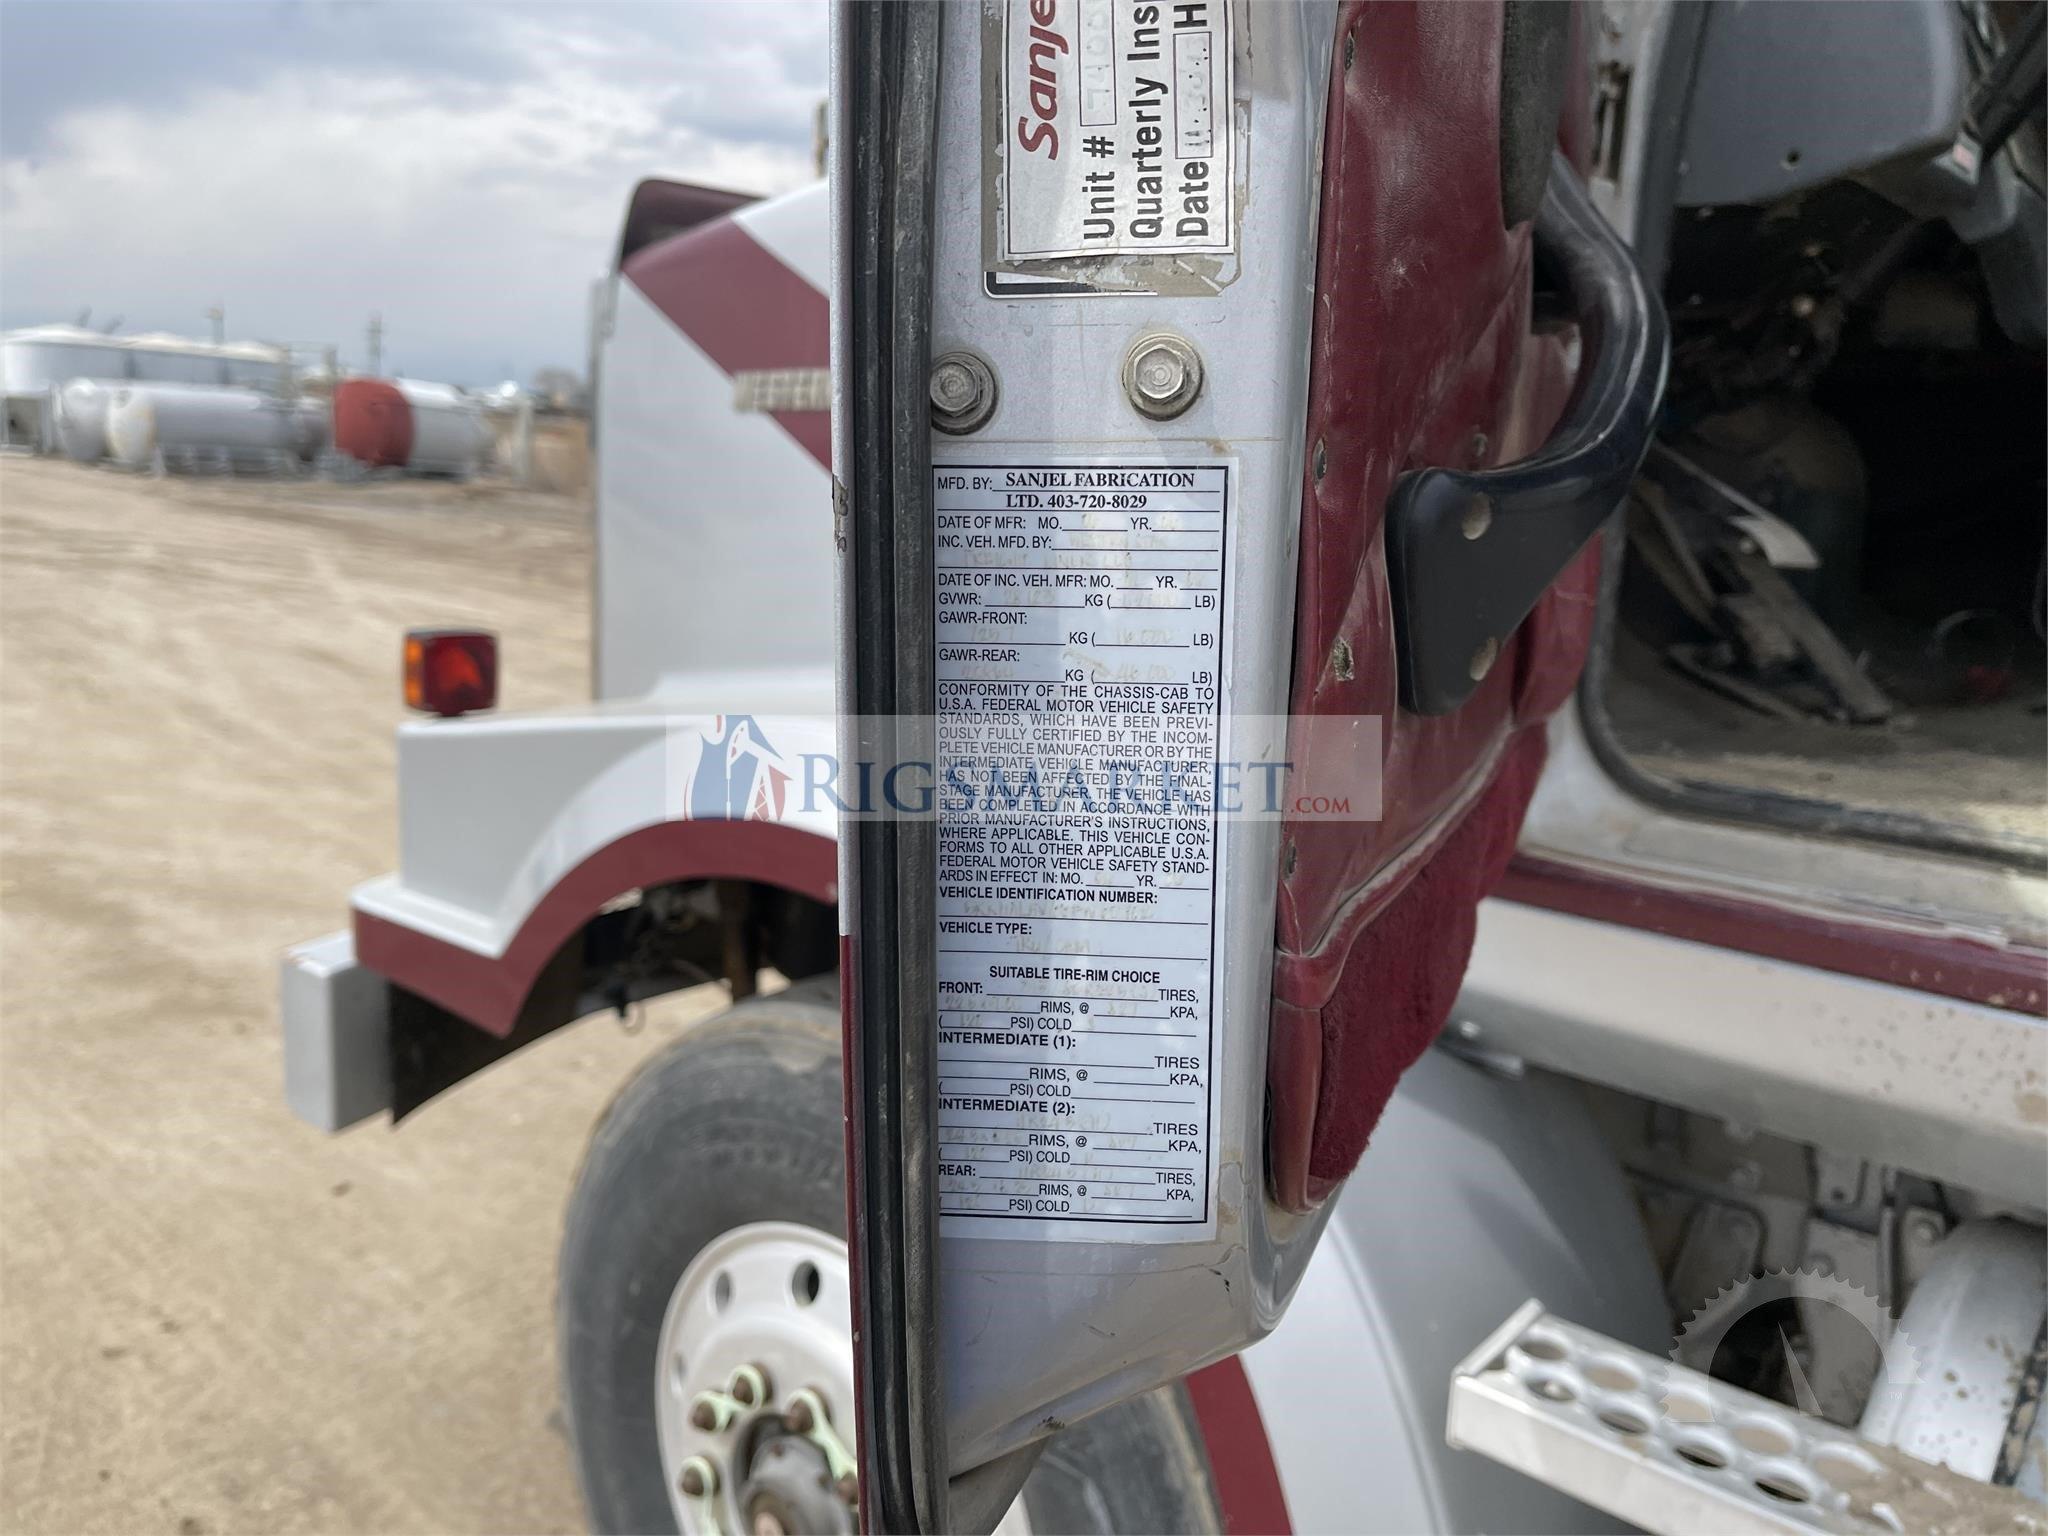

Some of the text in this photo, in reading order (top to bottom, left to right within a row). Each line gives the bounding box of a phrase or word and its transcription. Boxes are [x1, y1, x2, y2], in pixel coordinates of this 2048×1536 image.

[1127, 0, 1168, 239] Quarterly Ins
[1082, 136, 1115, 239] Unit #
[1176, 161, 1209, 237] Date
[938, 473, 1194, 490] MFD. BY: SANJEL FABRICATION
[1006, 495, 1147, 509] LTD. 403-720-8029
[938, 517, 971, 528] DATE
[974, 517, 991, 528] OF
[995, 517, 1026, 529] MFR:
[1038, 517, 1062, 529] MO.
[1131, 518, 1151, 530] YR.
[938, 536, 1051, 549] INC. VEH. MFD. BY:
[938, 574, 971, 586] DATE
[974, 574, 991, 586] OF
[995, 574, 1020, 586] INC.
[1023, 575, 1052, 587] VEH.
[1056, 575, 1086, 587] MFR:
[1090, 576, 1113, 588] MO.
[1156, 576, 1177, 589] YR.
[939, 593, 1215, 608] GVWR: KG LB)
[939, 612, 1027, 624] GAWR-FRONT:
[1070, 633, 1213, 647] KG LB)
[939, 650, 1019, 661] GAWR-REAR:
[1065, 670, 1212, 685] KG LB)
[939, 684, 1214, 699] CONFORMITY OF THE CHASSIS-CAB TO
[939, 698, 1213, 714] U.S.A. FEDERAL MOTOR VEHICLE SAFETY
[939, 713, 1213, 728] STANDARDS, WHICH HAVE BEEN PREVI-
[939, 727, 1212, 743] OUSLY FULLY CERTIFIED BY THE INCOM-
[940, 742, 1212, 758] PLETE VEHICLE MANUFACTURER OR BY THE
[940, 756, 1211, 774] INTERMEDIATE VEHICLE MANUFACTURER,
[940, 771, 1211, 787] HAS NOT BEEN AFFECTED BY THE FINAL-
[940, 785, 1211, 801] STAGE MANUFACTURER. THE VEHICLE HAS
[940, 799, 1210, 816] BEEN COMPLETED IN ACCORDANCE WITH
[940, 814, 1209, 832] PRIOR MANUFACTURER'S INSTRUCTIONS,
[940, 828, 1209, 845] WHERE APPLICABLE. THIS VEHICLE CON-
[940, 842, 1208, 859] FORMS TO ALL OTHER APPLICABLE U.S.A.
[940, 856, 1209, 873] FEDERAL MOTOR VEHICLE SAFETY STAND-
[940, 870, 974, 881] ARDS
[976, 871, 988, 882] IN
[991, 871, 1037, 883] EFFECT
[1042, 872, 1058, 884] IN:
[1061, 873, 1083, 884] MO.
[1137, 875, 1156, 887] YR.
[940, 887, 1157, 904] VEHICLE IDENTIFICATION NUMBER:
[940, 922, 1031, 935] VEHICLE TYPE:
[990, 966, 1160, 983] SUITABLE TIRE-RIM CHOICE
[939, 982, 983, 994] FRONT:
[1158, 989, 1198, 1003] TIRES,
[1041, 1002, 1198, 1020] RIMS, @ KPA,
[1010, 1018, 1071, 1030] PSI) COLD
[939, 1032, 1076, 1048] INTERMEDIATE (1):
[1155, 1057, 1199, 1069] TIRES
[1029, 1068, 1203, 1088] RIMS, @ KPA,
[1010, 1084, 1071, 1097] PSI) COLD
[939, 1099, 1075, 1115] INTERMEDIATE (2):
[1153, 1123, 1198, 1136] TIRES
[1029, 1135, 1201, 1154] RIMS, @ KPA,
[1009, 1151, 1070, 1164] PSI) COLD
[939, 1166, 1195, 1187] REAR: TIRES,
[1039, 1184, 1072, 1197] RIMS,
[1077, 1185, 1087, 1197] @
[1166, 1189, 1194, 1202] KPA,
[1009, 1200, 1070, 1212] PSI) COLD
